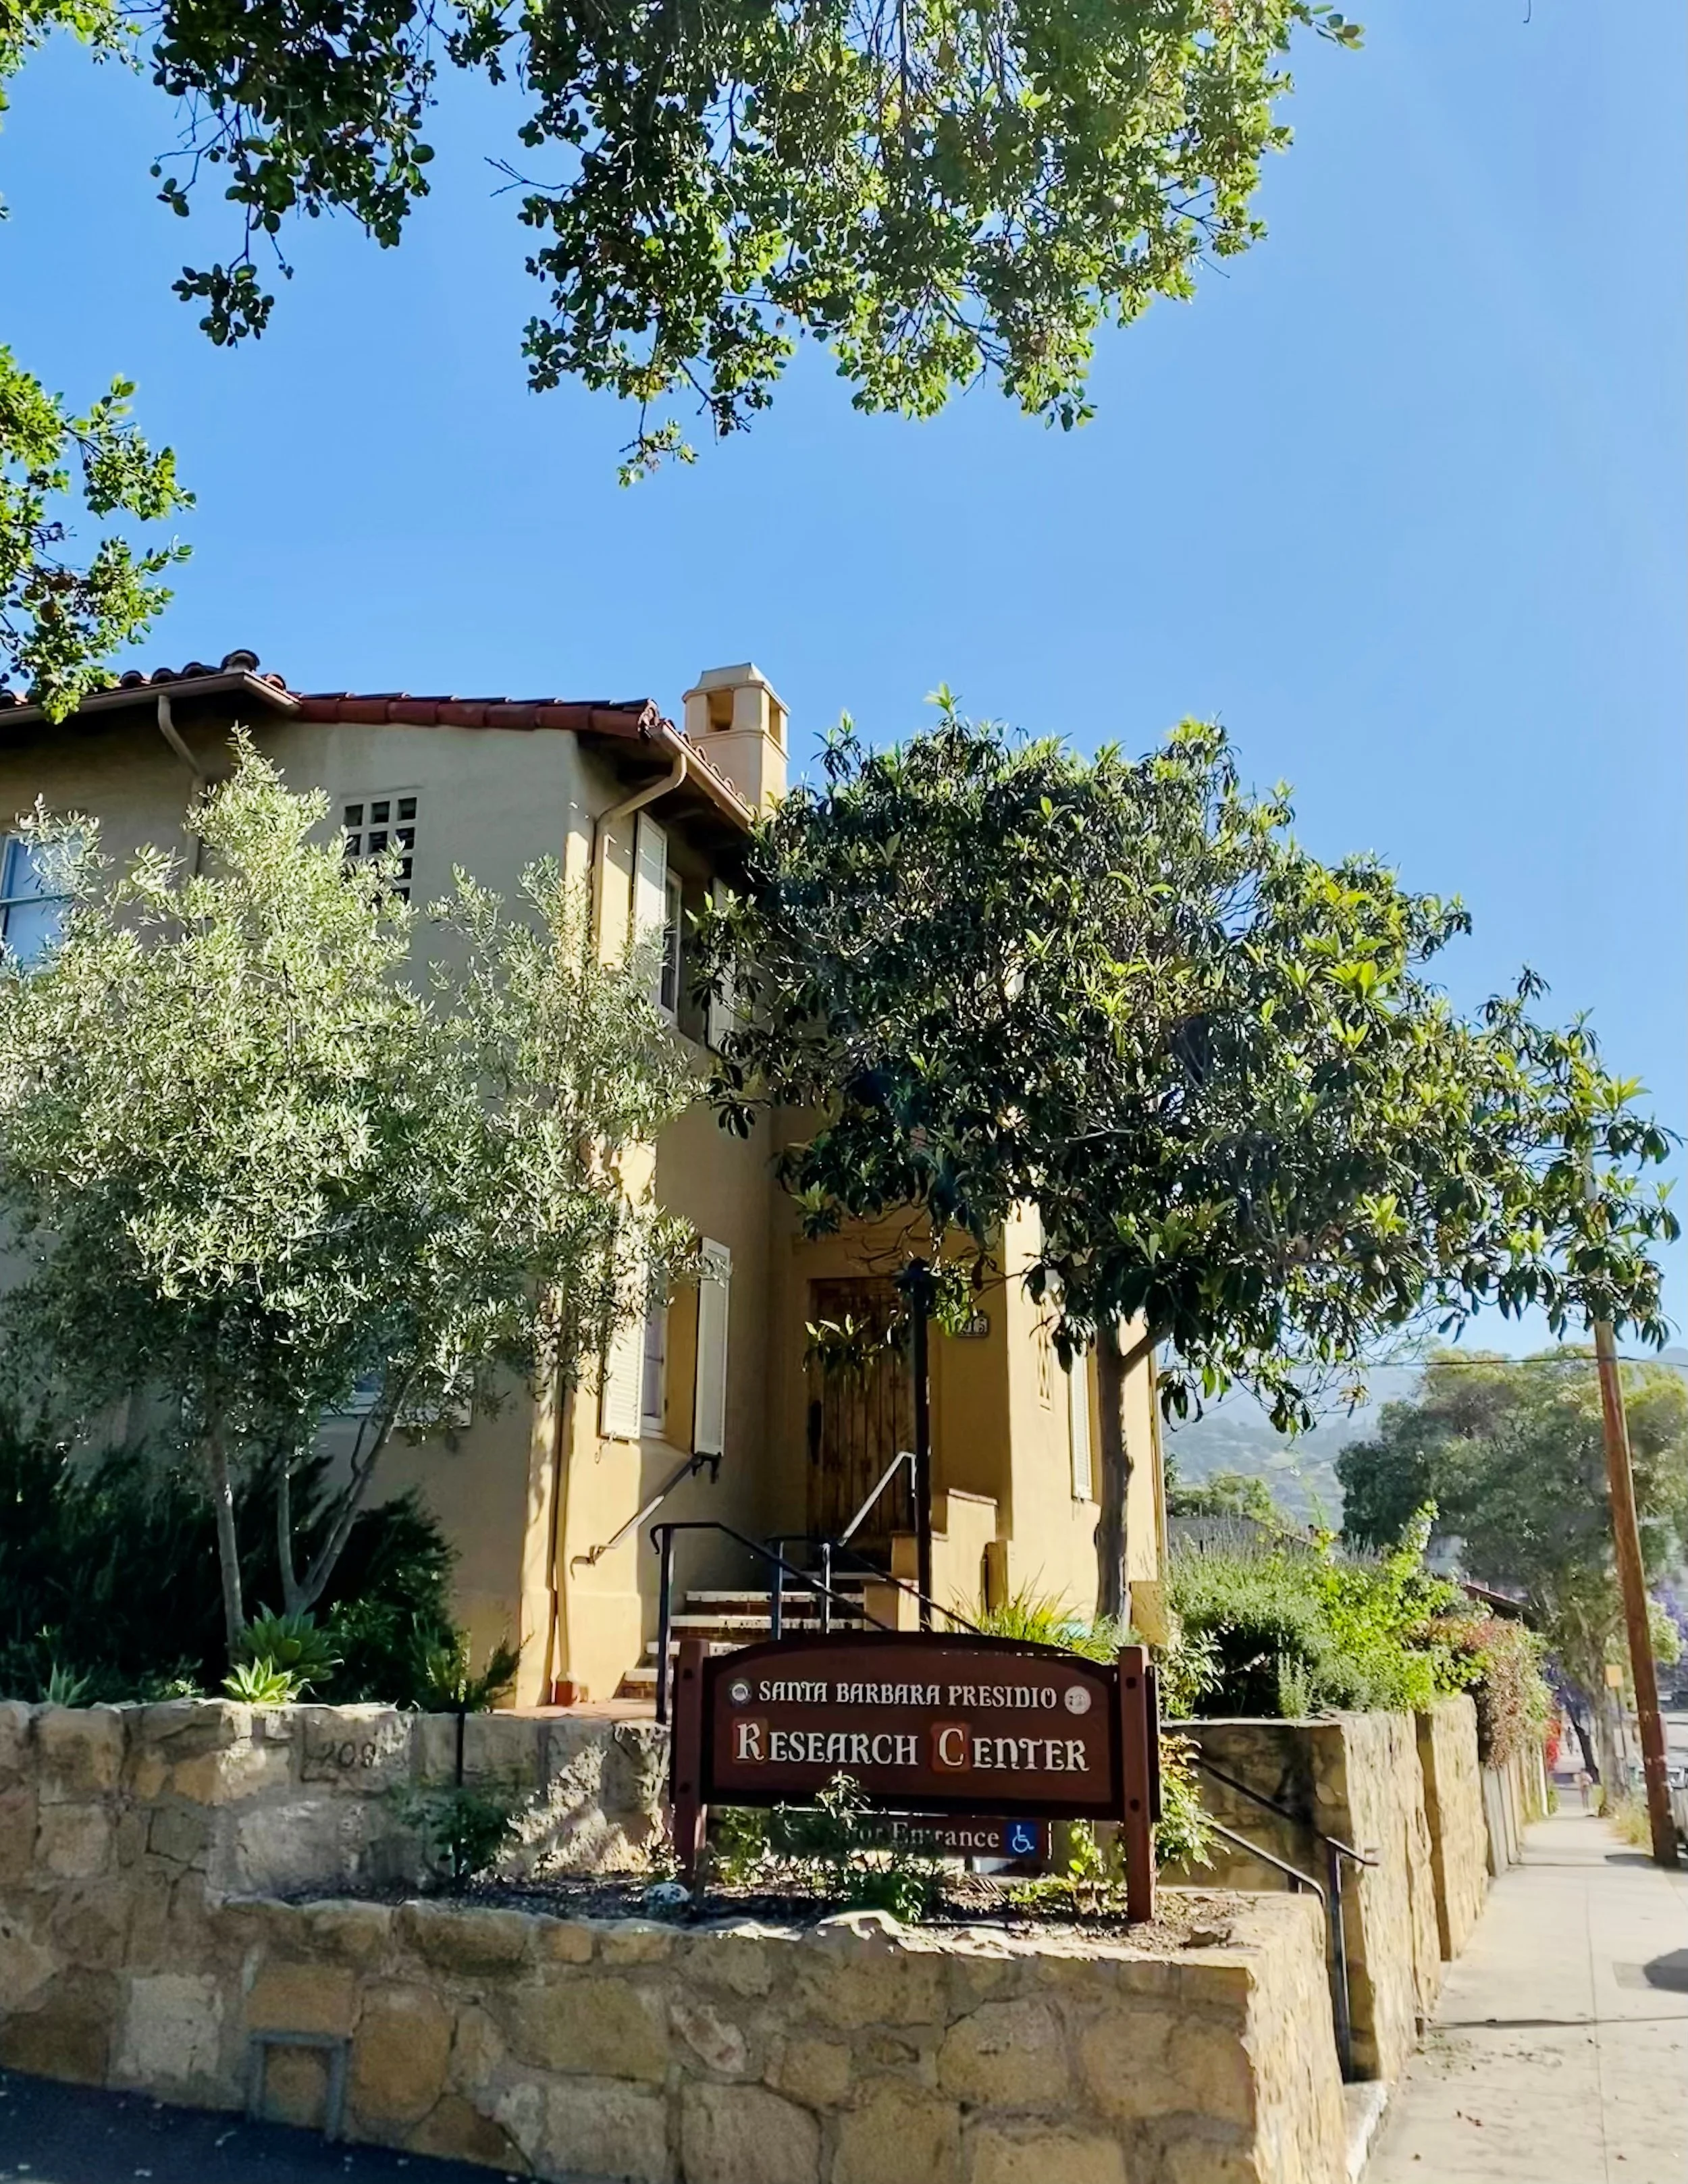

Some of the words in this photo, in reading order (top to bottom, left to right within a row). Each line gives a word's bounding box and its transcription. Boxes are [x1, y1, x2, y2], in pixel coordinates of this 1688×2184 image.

[758, 1680, 828, 1702] SANTA
[836, 1682, 941, 1705] BARBARA
[948, 1685, 1057, 1709] PRESIDIO
[737, 1722, 919, 1765] RESEARCH
[939, 1728, 1090, 1772] CENTER
